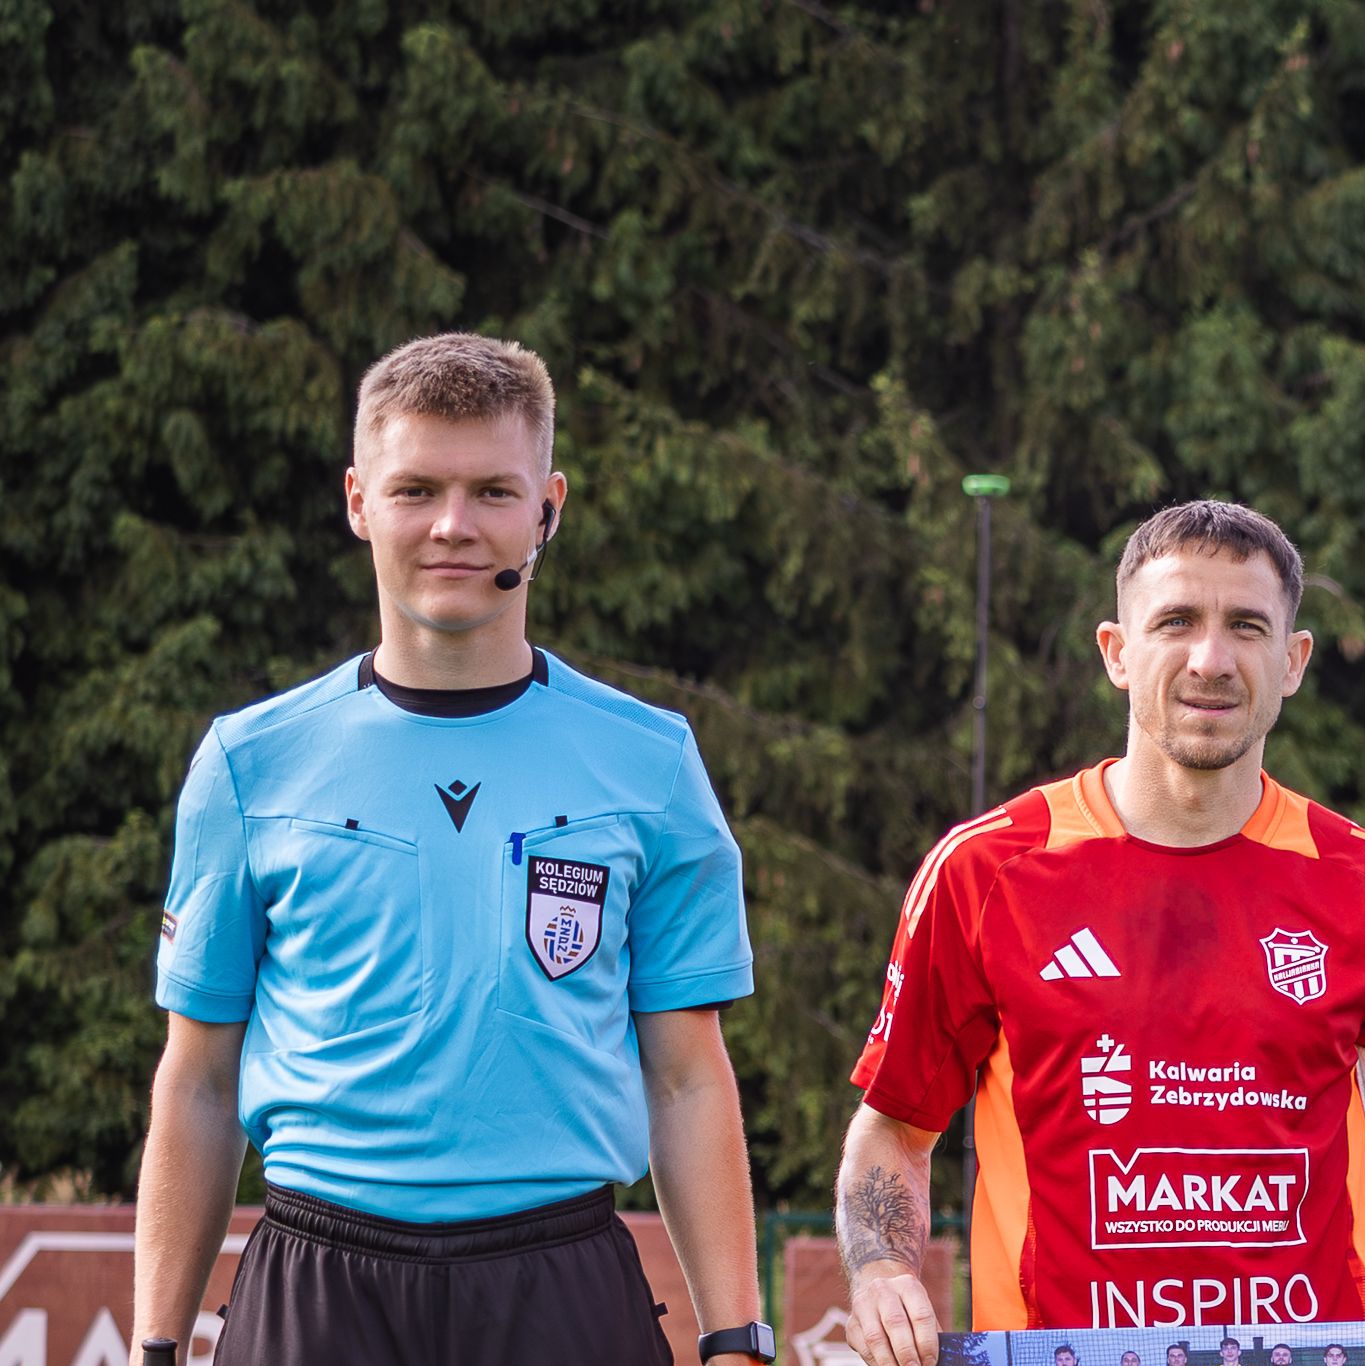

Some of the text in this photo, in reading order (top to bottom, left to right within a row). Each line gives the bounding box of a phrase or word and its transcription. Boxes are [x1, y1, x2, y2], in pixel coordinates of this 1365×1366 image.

[535, 861, 603, 884] KOLEGIUM
[539, 877, 598, 898] SĘDZIÓW
[1149, 1060, 1256, 1082] Kalwaria
[1150, 1085, 1307, 1111] Zebrzydowska
[1107, 1173, 1296, 1213] MARKAT
[1105, 1220, 1173, 1234] WSZYSTKO
[1175, 1219, 1196, 1232] DO
[1197, 1219, 1261, 1233] PRODUKCJI
[1090, 1273, 1318, 1329] INSPIRO
